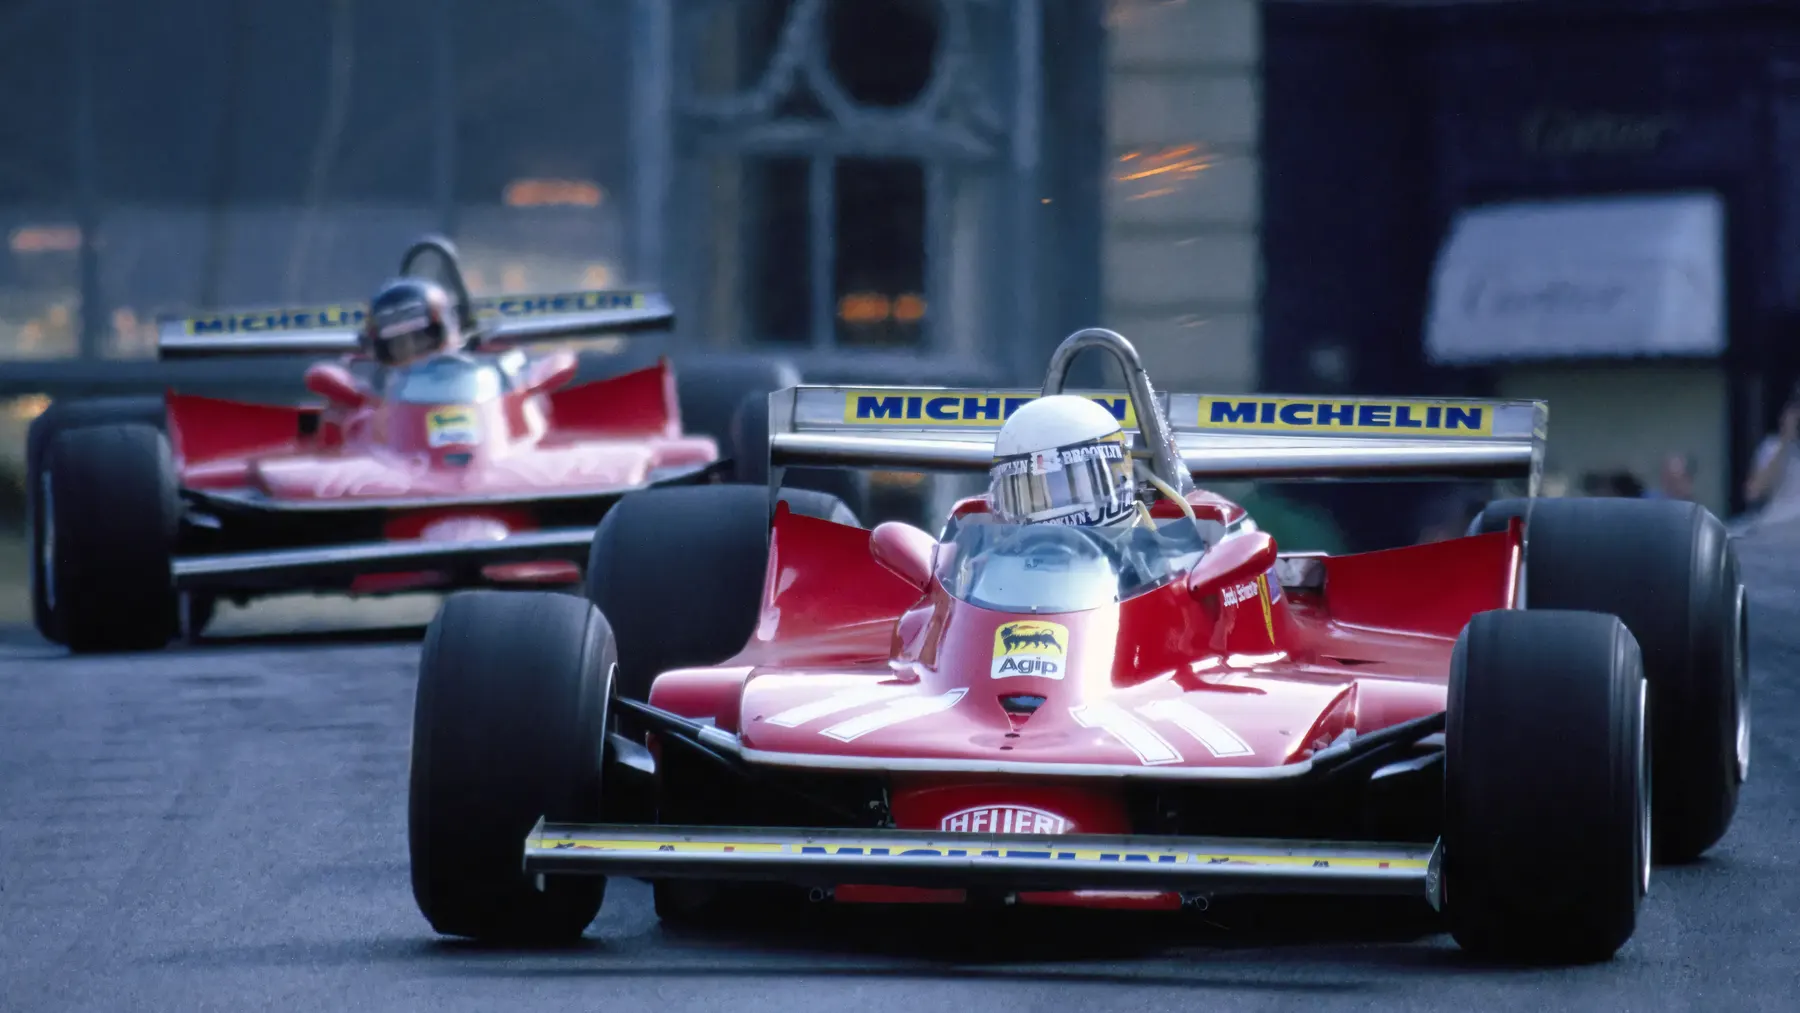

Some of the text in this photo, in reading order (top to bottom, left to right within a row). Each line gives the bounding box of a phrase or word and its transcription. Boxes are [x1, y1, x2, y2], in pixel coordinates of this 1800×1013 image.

[856, 396, 1126, 421] MICHN
[1210, 401, 1482, 430] MICHELIN
[1061, 444, 1123, 465] BROOKLYN
[999, 657, 1058, 675] Agip
[1068, 699, 1255, 765] 11
